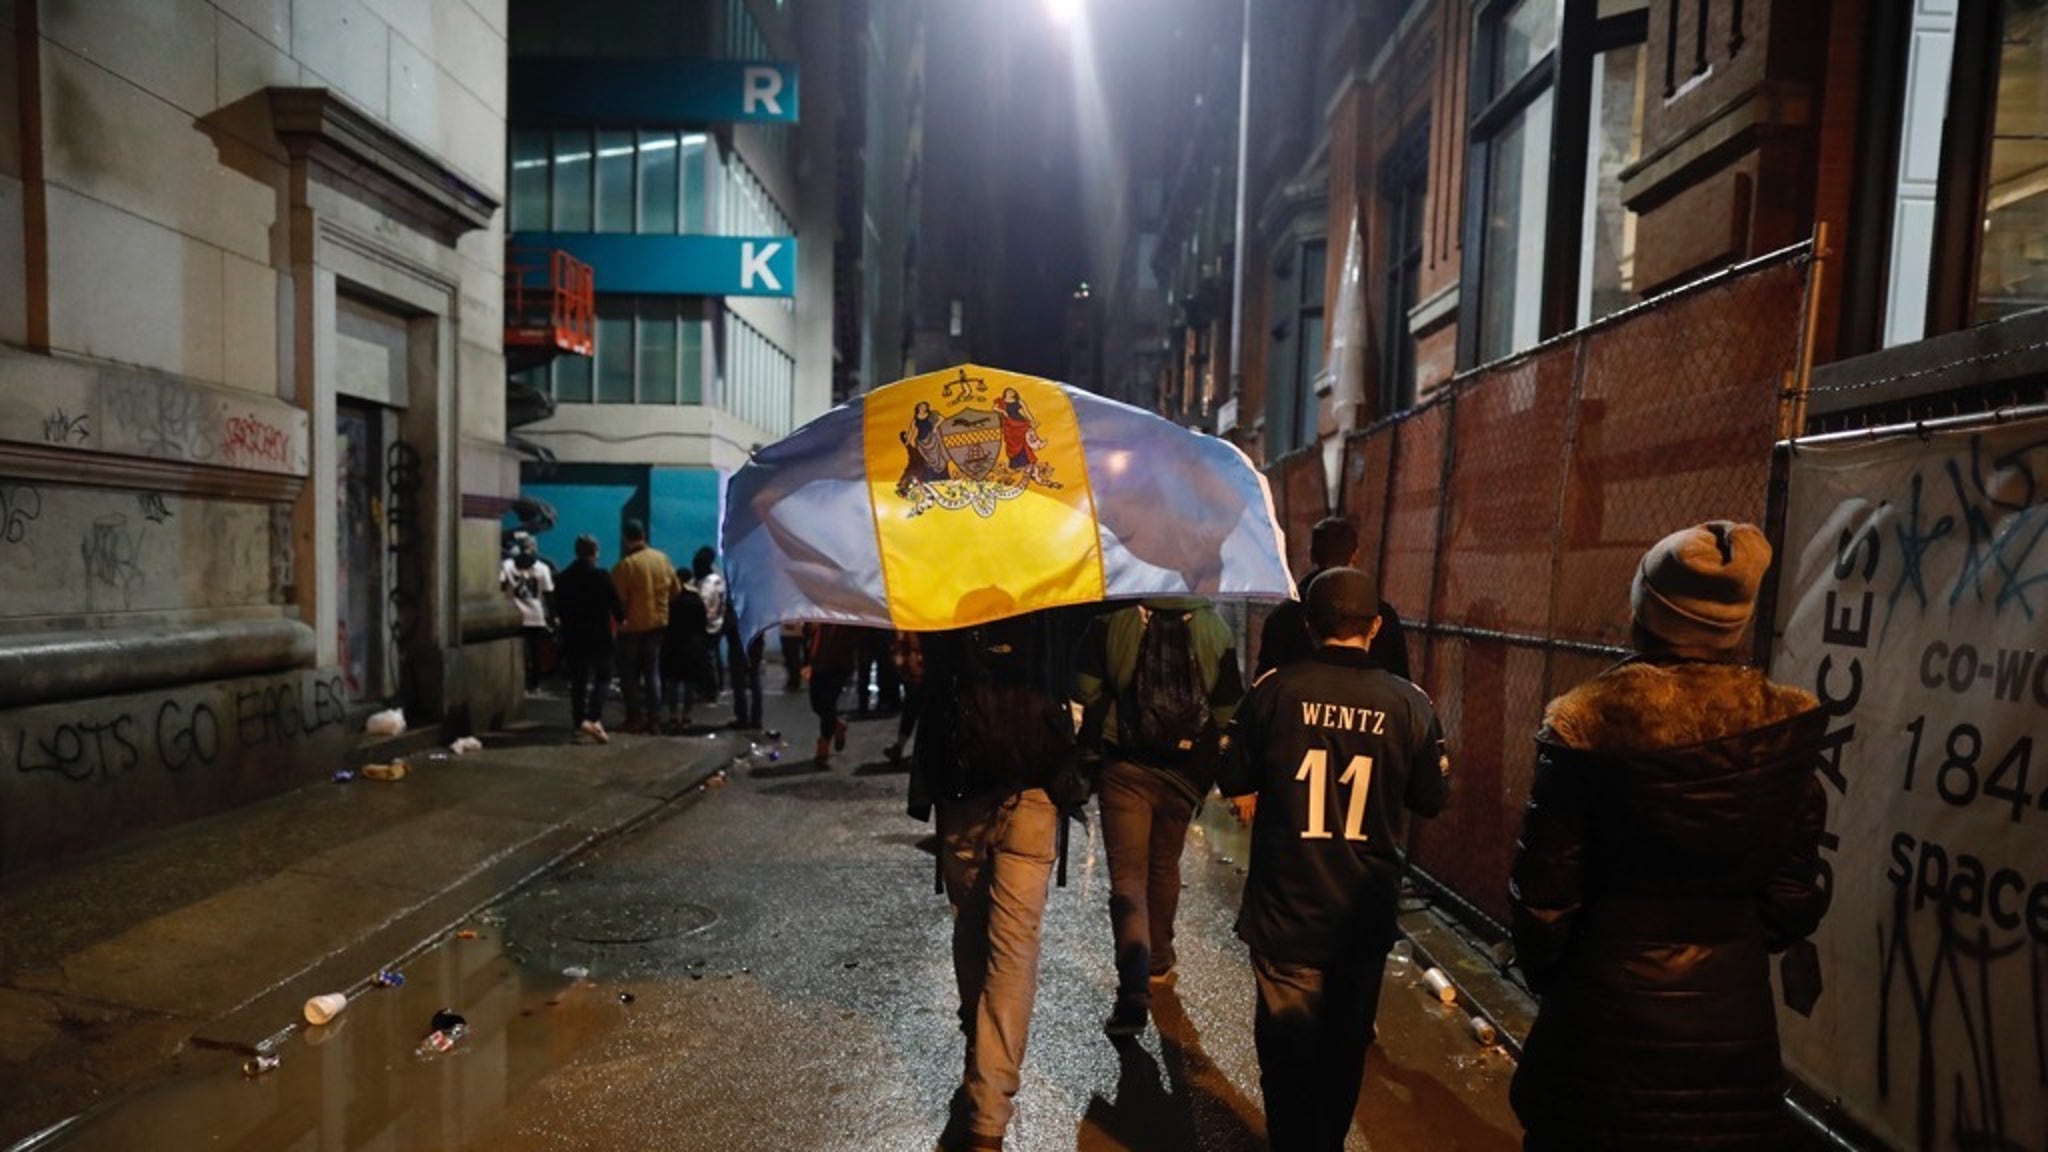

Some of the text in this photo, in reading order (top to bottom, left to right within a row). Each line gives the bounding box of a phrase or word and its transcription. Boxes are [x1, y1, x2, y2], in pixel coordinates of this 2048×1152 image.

[743, 66, 783, 115] R
[740, 241, 783, 290] K
[155, 699, 221, 772] GO
[1301, 701, 1387, 736] WENTZ
[1813, 525, 1881, 918] ACES
[1294, 748, 1374, 841] 11
[1902, 714, 2048, 823] 184
